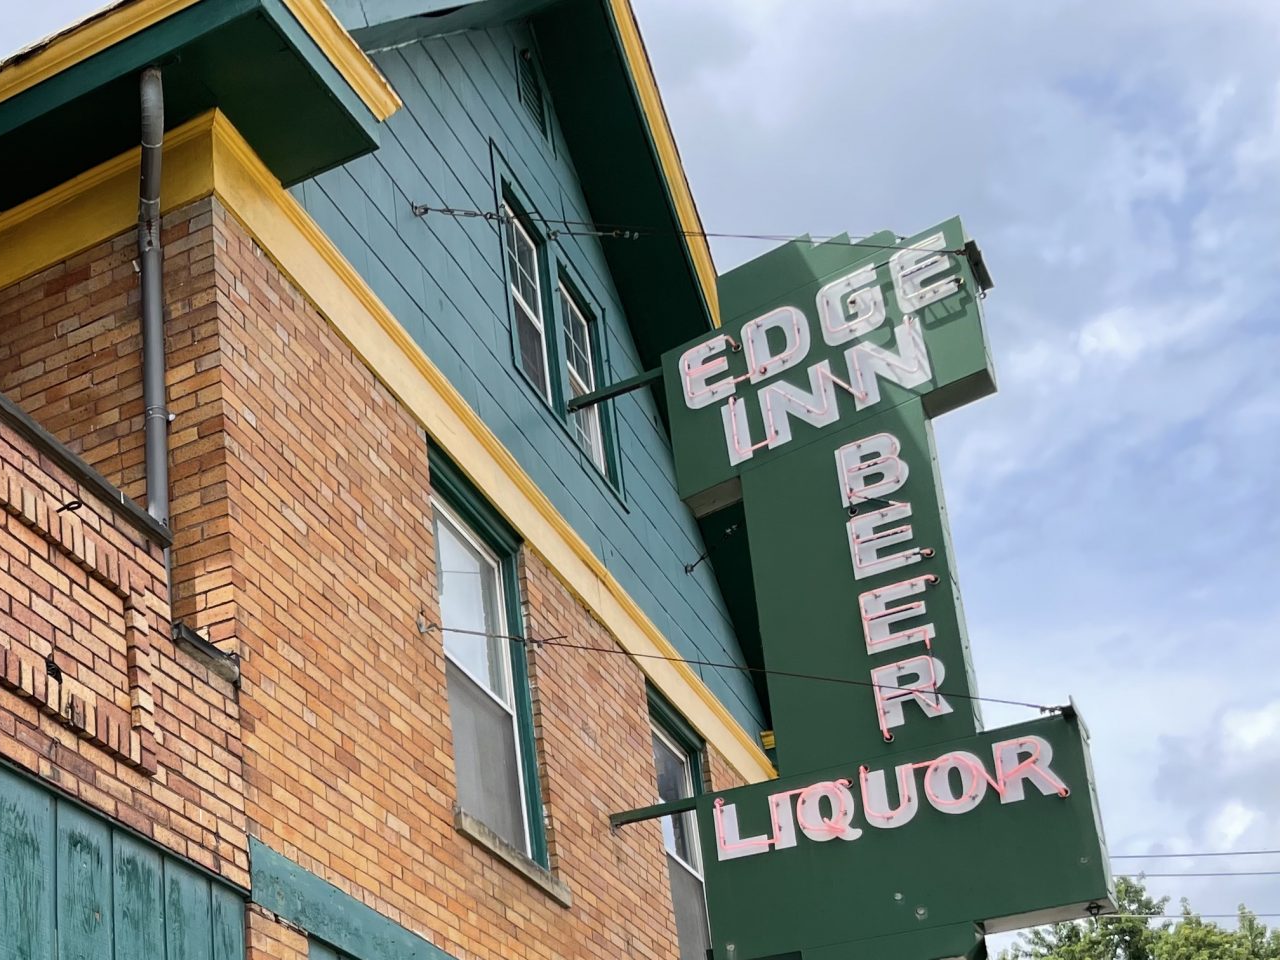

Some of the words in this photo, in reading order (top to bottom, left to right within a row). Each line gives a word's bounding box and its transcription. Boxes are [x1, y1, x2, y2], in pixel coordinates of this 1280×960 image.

[678, 231, 962, 409] EDGE
[721, 316, 932, 467] INN
[835, 432, 953, 733] BEER
[713, 735, 1070, 861] LIQUOR
